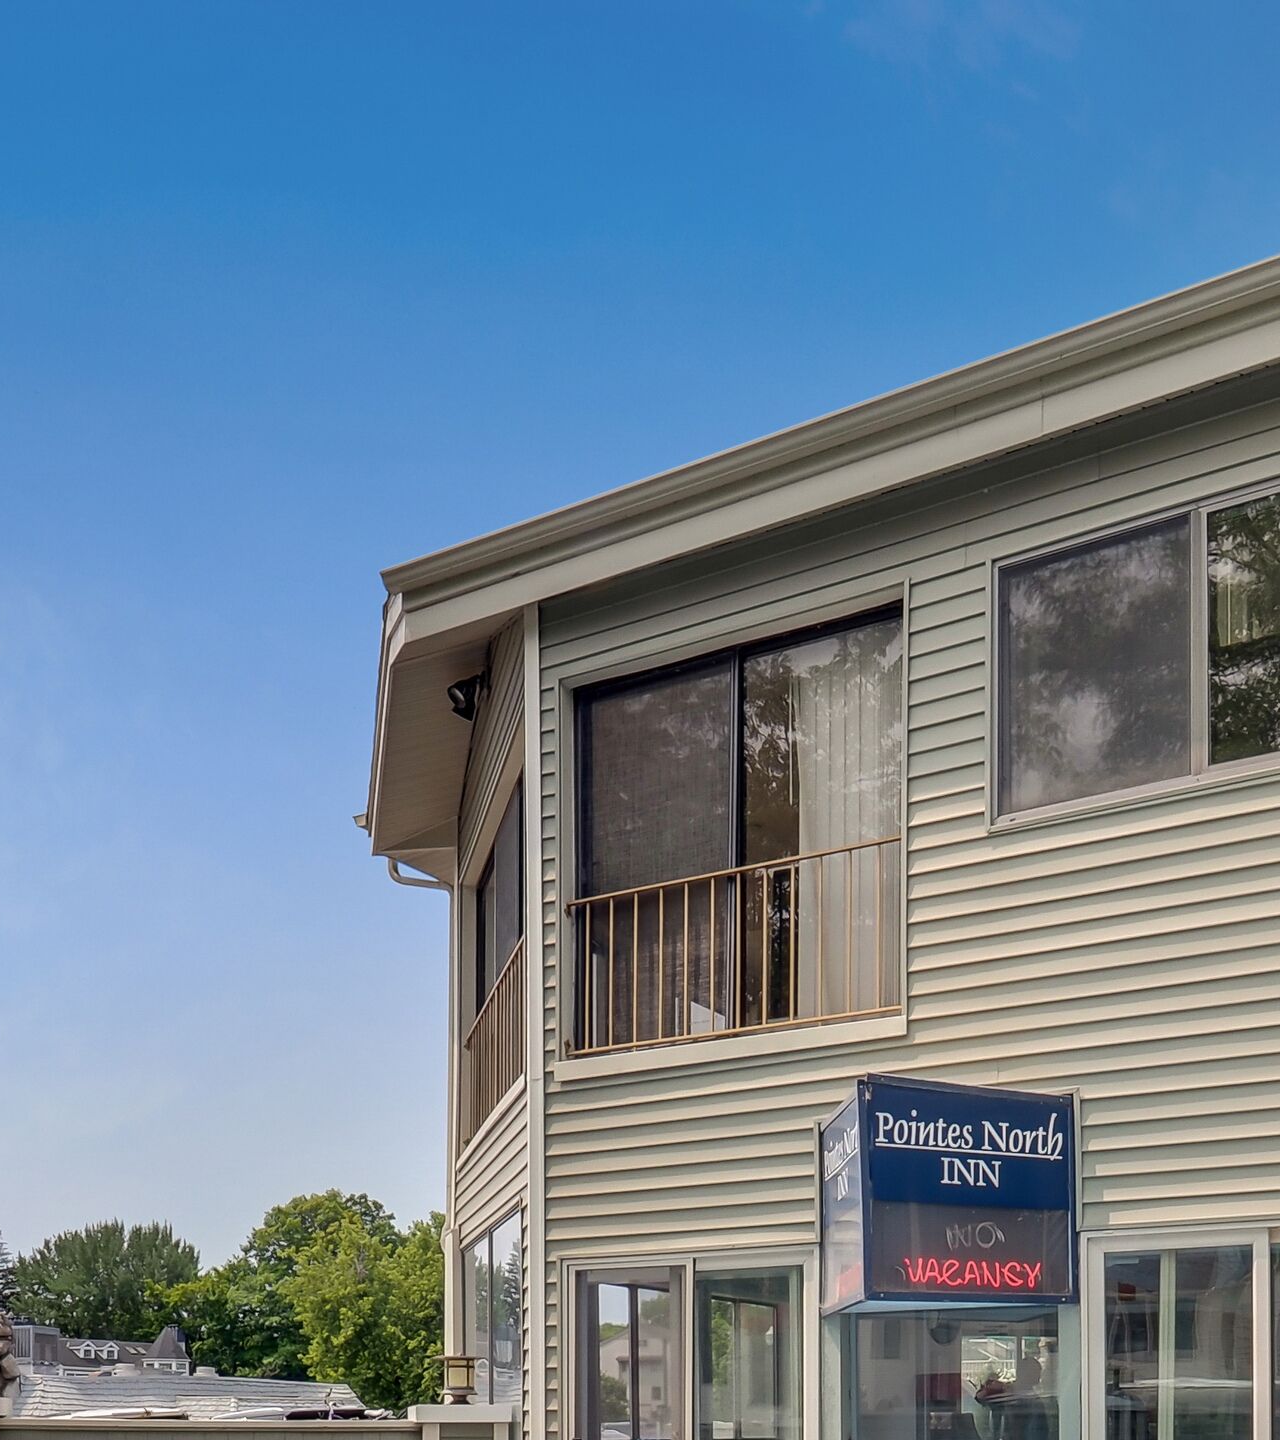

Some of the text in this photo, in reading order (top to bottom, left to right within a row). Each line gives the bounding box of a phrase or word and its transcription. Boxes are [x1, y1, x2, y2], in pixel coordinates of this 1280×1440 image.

[875, 1109, 973, 1149] Pointes
[981, 1112, 1064, 1161] North
[940, 1156, 1002, 1188] INN
[945, 1221, 998, 1250] NO
[904, 1257, 1042, 1288] VACANCY
